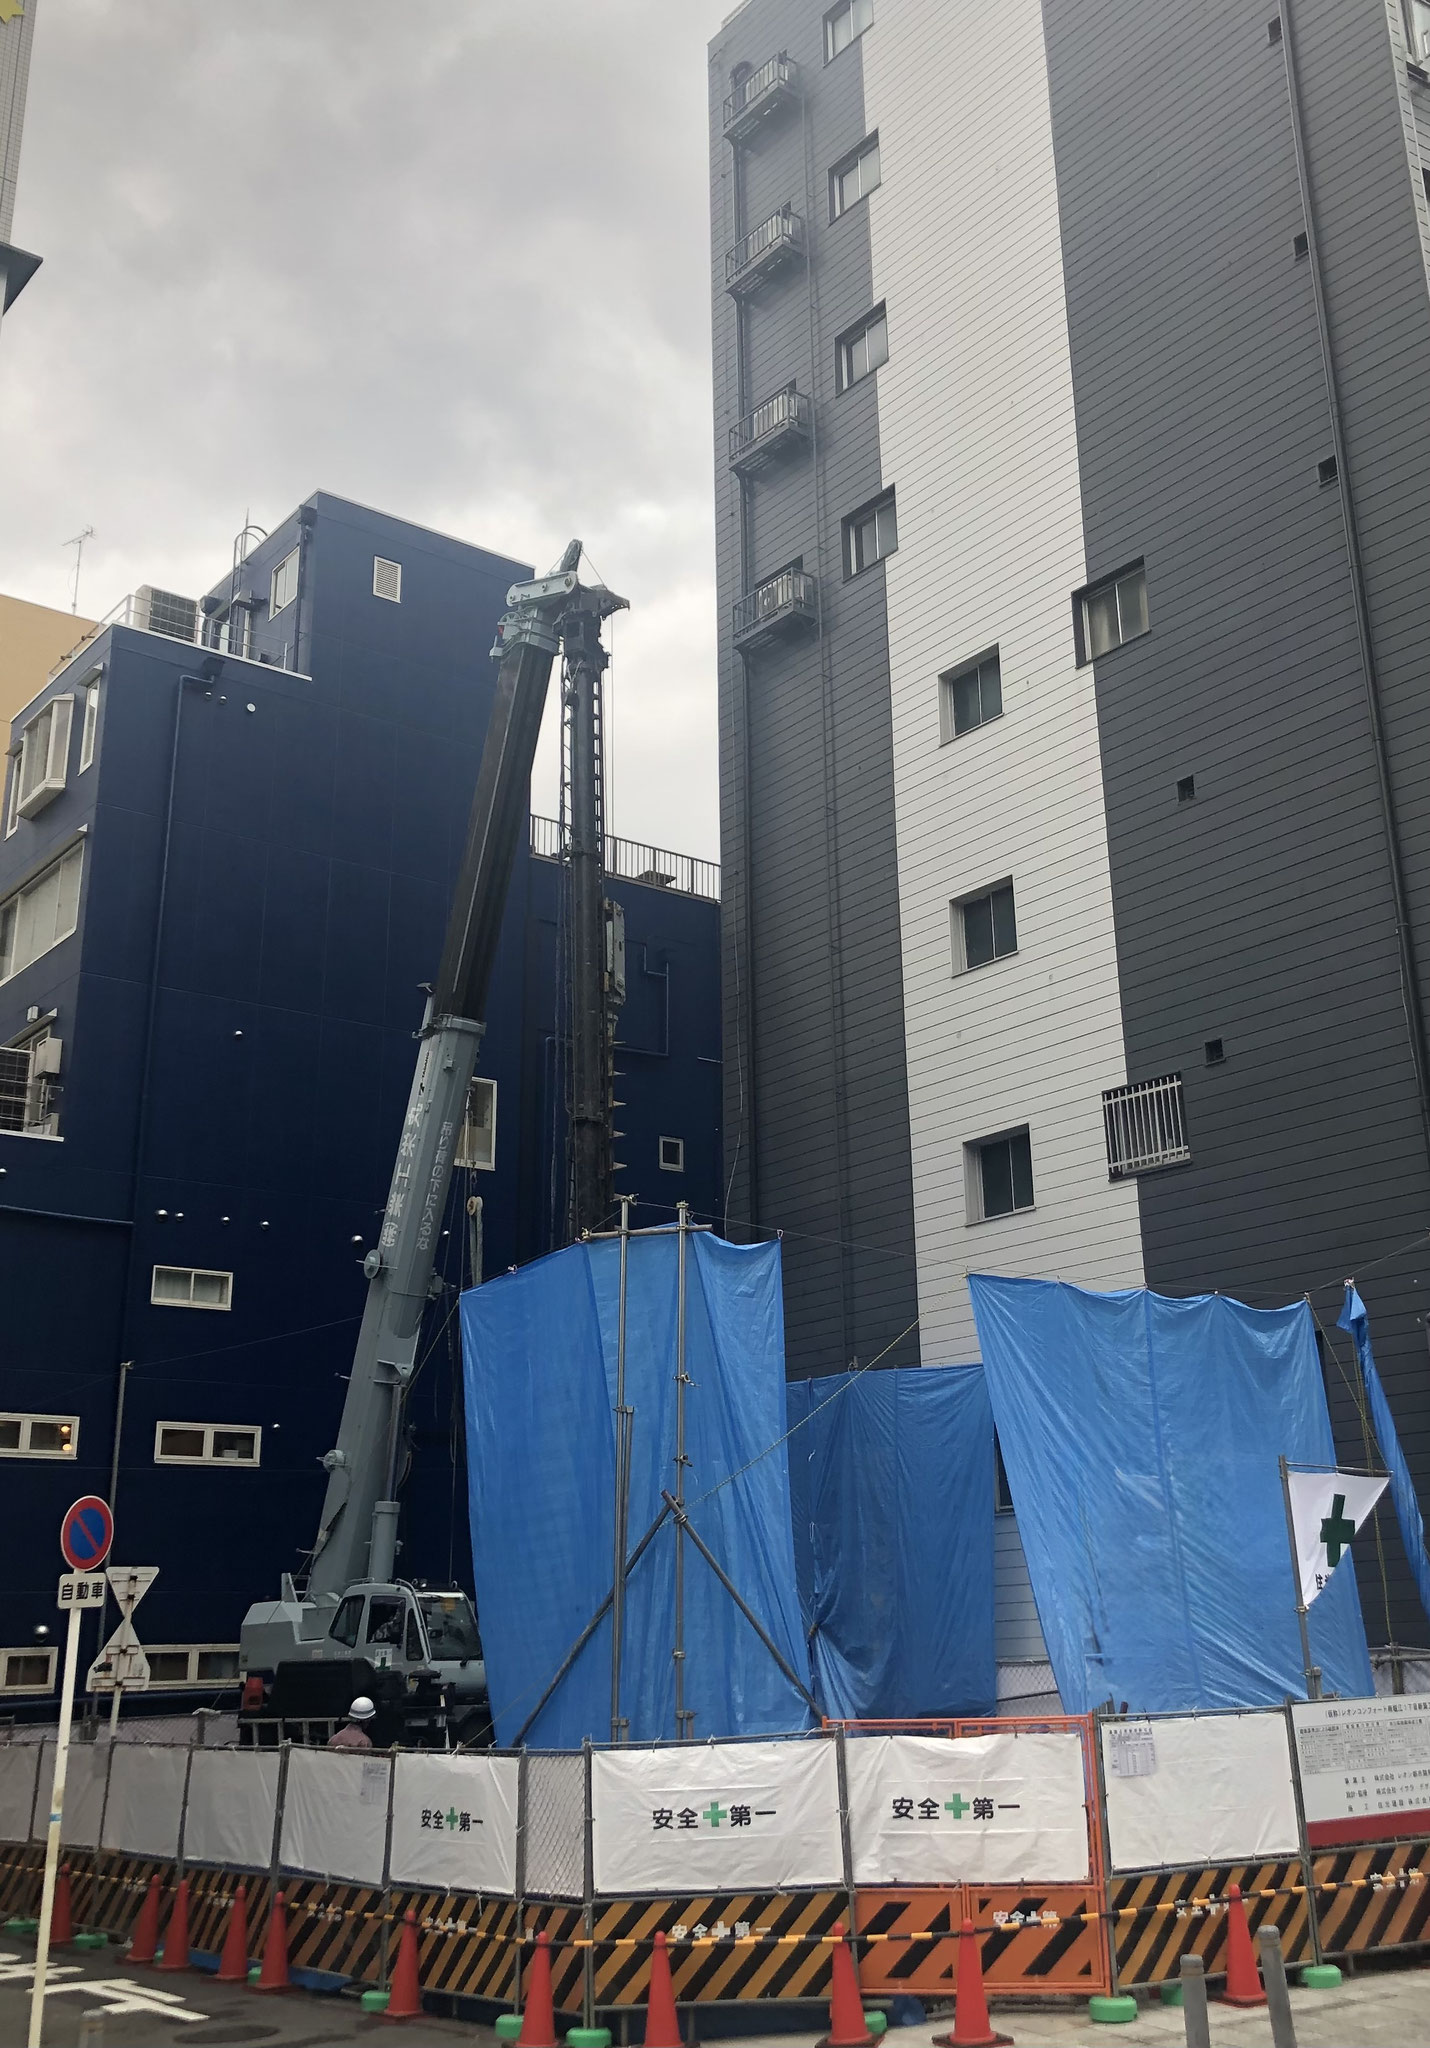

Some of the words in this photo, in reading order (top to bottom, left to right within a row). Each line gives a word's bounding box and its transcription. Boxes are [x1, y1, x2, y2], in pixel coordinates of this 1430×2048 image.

[416, 1121, 453, 1250] 吊り荷の下に入るな
[62, 1581, 104, 1600] 自動車
